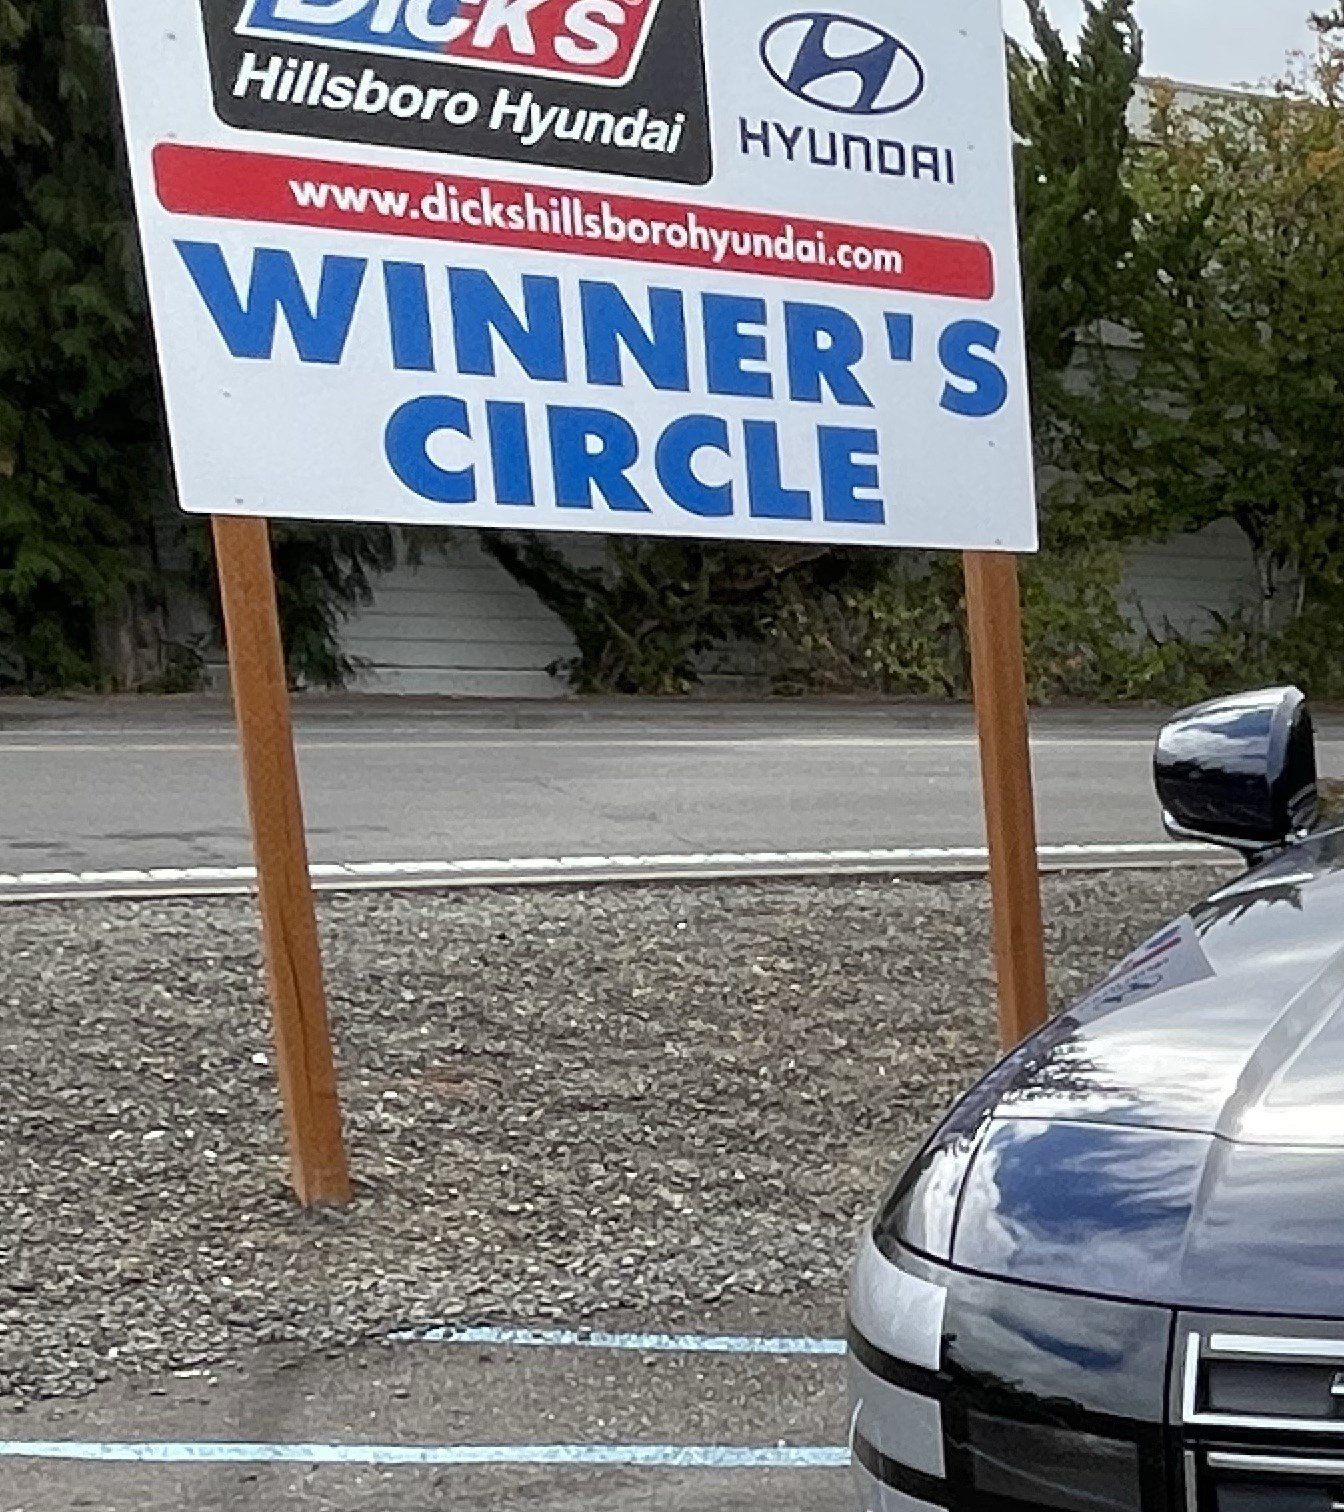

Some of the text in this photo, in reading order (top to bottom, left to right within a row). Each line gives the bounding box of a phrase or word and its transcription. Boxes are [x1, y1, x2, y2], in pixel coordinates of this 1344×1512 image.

[233, 52, 686, 153] Hillsboro Hyundai
[738, 116, 954, 184] HYUNDAI
[288, 180, 903, 274] www.dickshillsborohyundai.com
[173, 240, 1008, 416] WINNER'S
[384, 395, 886, 524] CIRCLE
